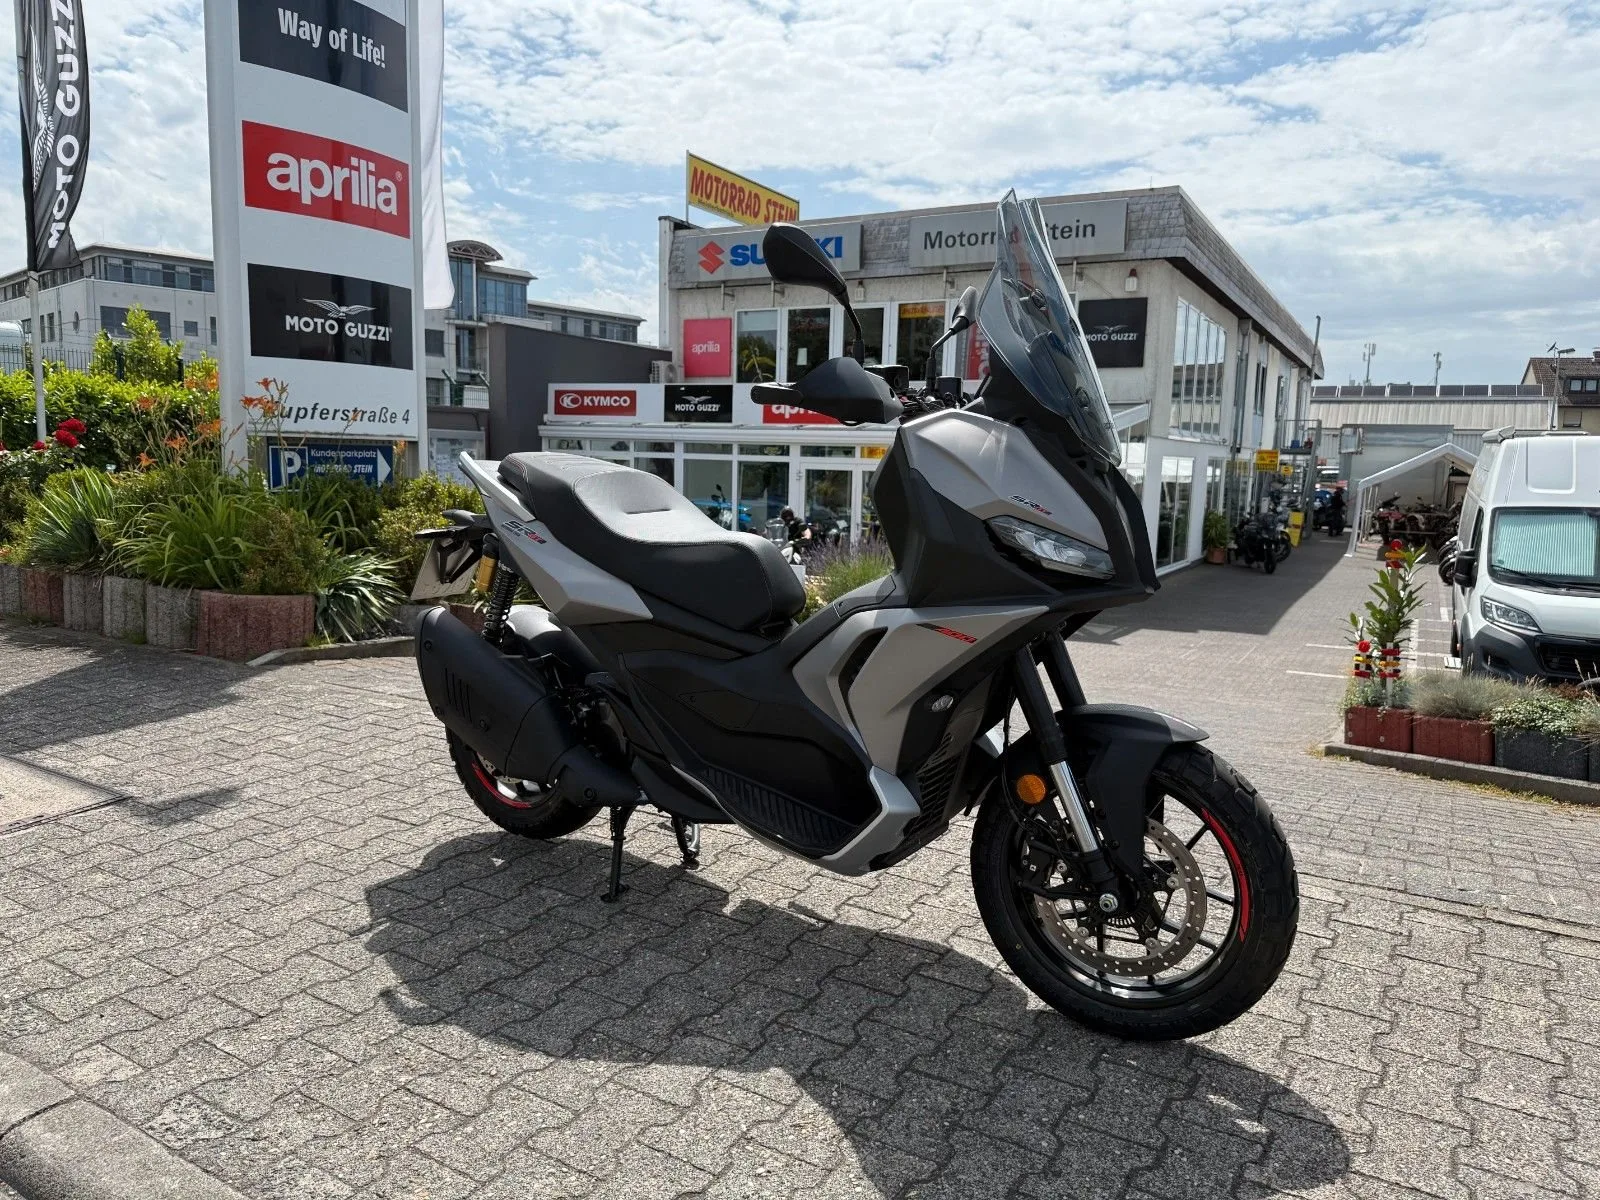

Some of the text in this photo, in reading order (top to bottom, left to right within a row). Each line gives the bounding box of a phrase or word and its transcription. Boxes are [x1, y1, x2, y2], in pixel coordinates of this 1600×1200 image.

[277, 8, 386, 69] Way of Life!
[48, 134, 80, 249] MOTO
[267, 152, 398, 216] aprilia
[690, 166, 761, 219] MOTORRAD
[763, 198, 797, 224] STEIN
[923, 219, 1096, 250] Motorr tein
[729, 236, 843, 267] SUKI
[285, 315, 390, 341] MOTO GUZZI
[1085, 333, 1137, 341] MOTO GUZZI
[691, 340, 720, 355] aprilia
[266, 402, 411, 425] upferstraße 4
[583, 395, 631, 407] KYMCO
[674, 403, 720, 412] MOTO GUZZI
[353, 463, 374, 473] STEIN
